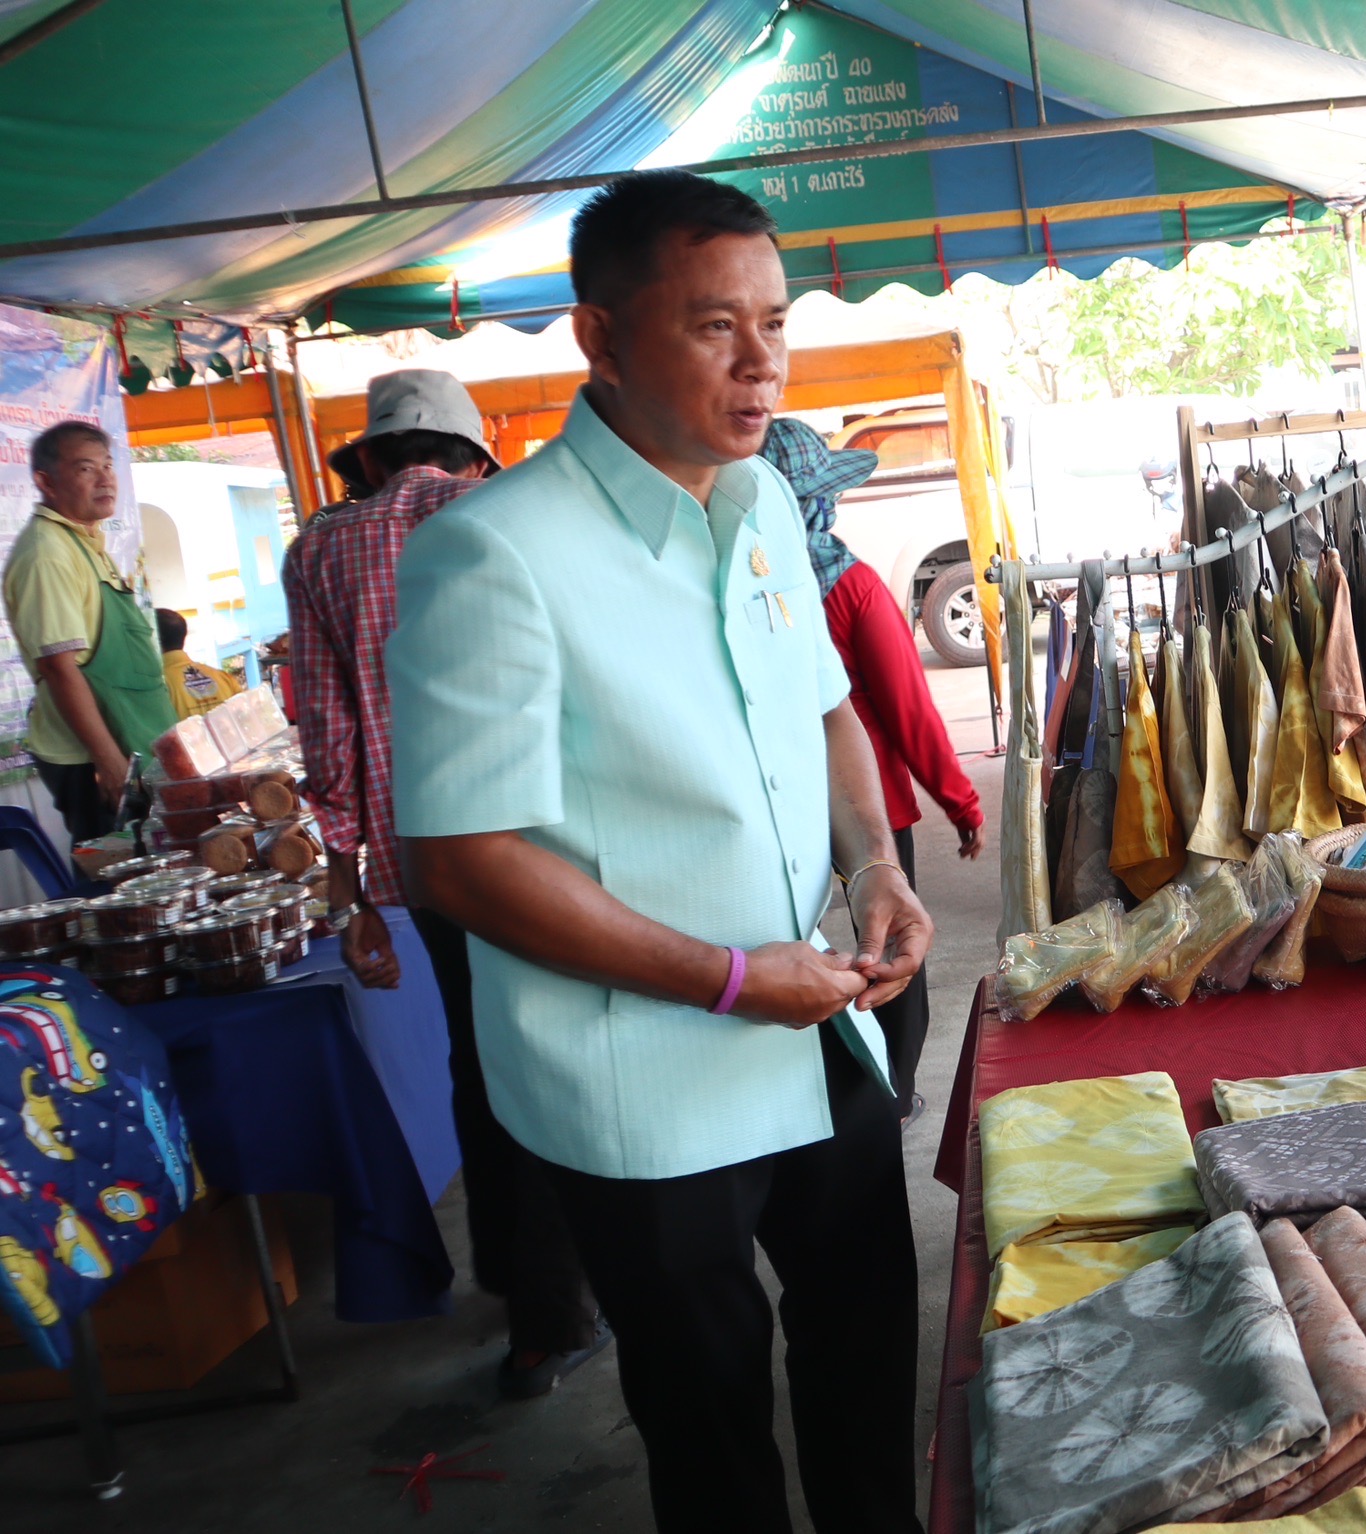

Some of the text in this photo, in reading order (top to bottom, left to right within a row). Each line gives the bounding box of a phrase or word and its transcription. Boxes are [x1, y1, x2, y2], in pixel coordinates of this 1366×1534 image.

[849, 57, 872, 76] 40
[843, 81, 906, 105] ฉายแสง
[762, 171, 788, 201] หมู่
[791, 175, 799, 194] 1
